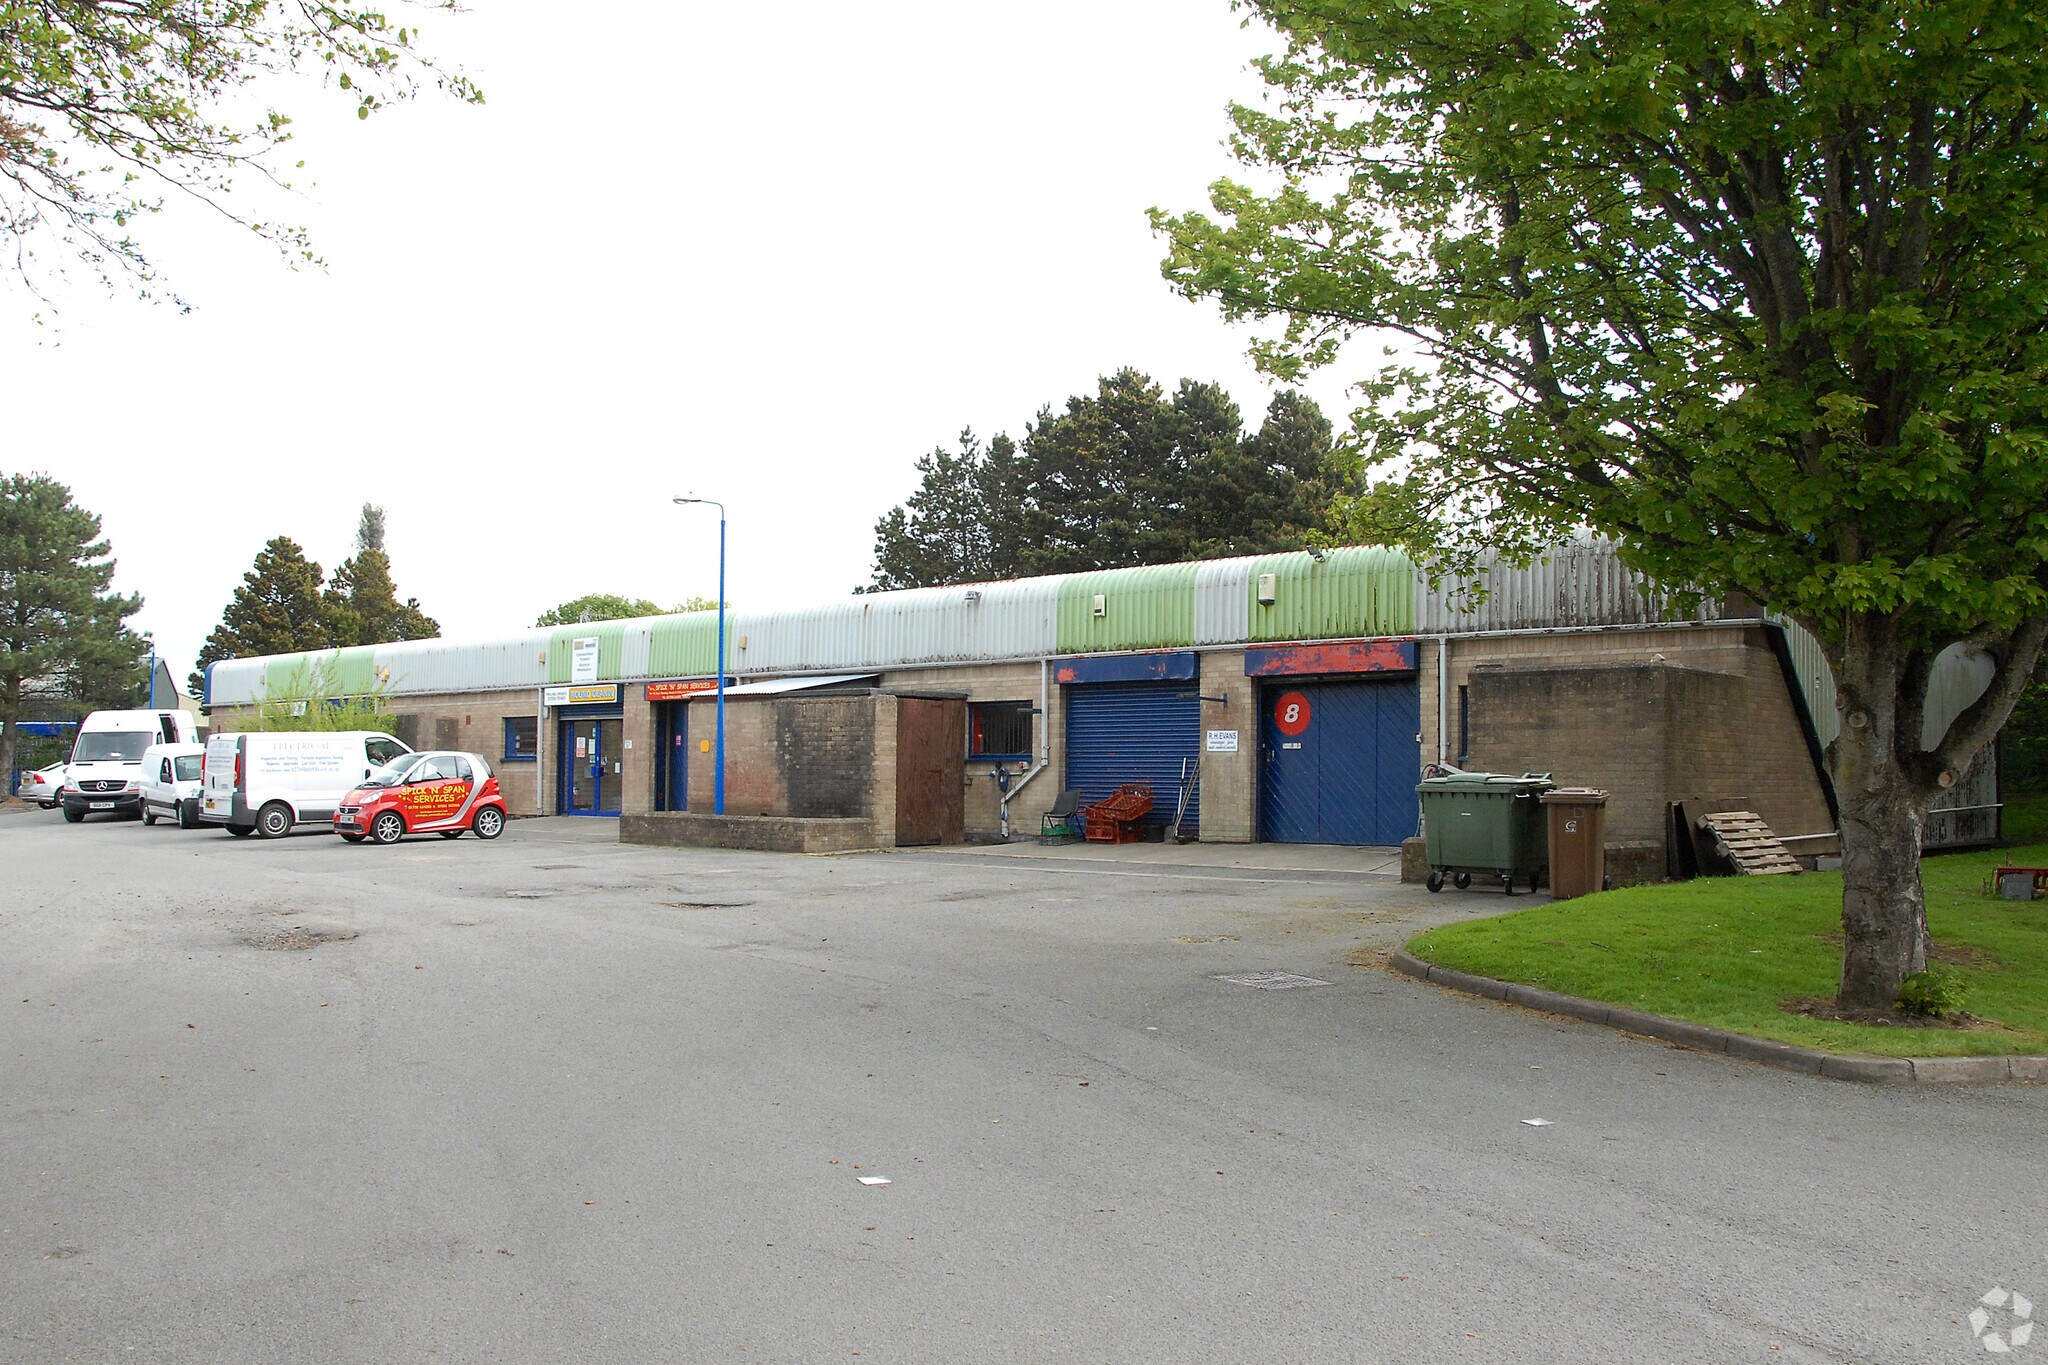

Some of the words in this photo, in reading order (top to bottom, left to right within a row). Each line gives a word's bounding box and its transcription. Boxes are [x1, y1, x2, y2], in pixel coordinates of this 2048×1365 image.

[690, 682, 711, 690] SERVICES
[1284, 703, 1300, 723] 8
[401, 787, 426, 796] SPICK
[443, 785, 466, 794] SPAN
[413, 794, 455, 804] SERVICES
